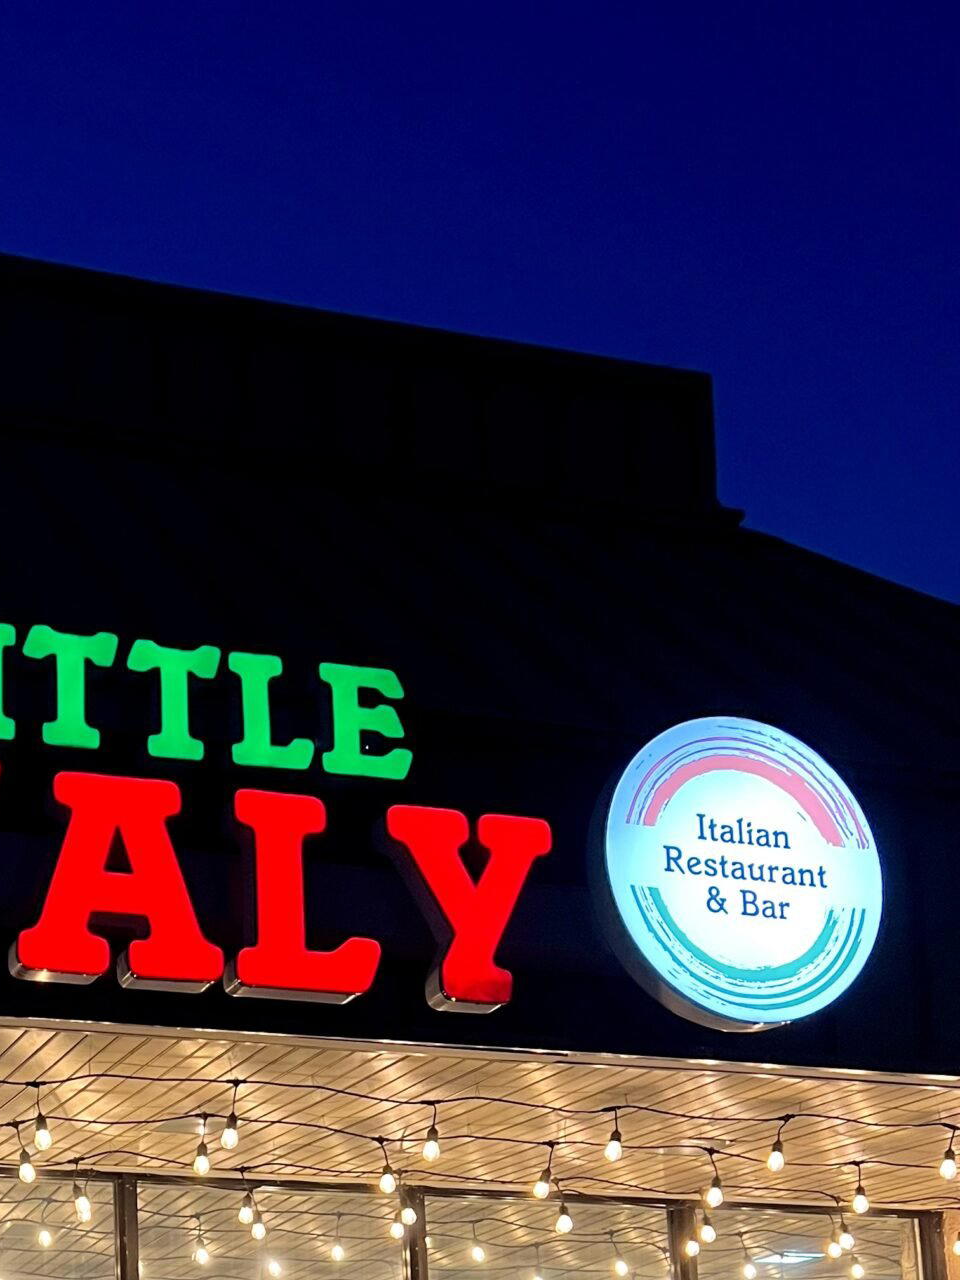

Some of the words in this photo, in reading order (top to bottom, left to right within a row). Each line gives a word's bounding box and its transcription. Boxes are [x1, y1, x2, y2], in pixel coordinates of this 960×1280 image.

[696, 813, 791, 849] Italian
[663, 845, 828, 889] Restaurant
[706, 886, 729, 915] &
[740, 889, 790, 920] Bar
